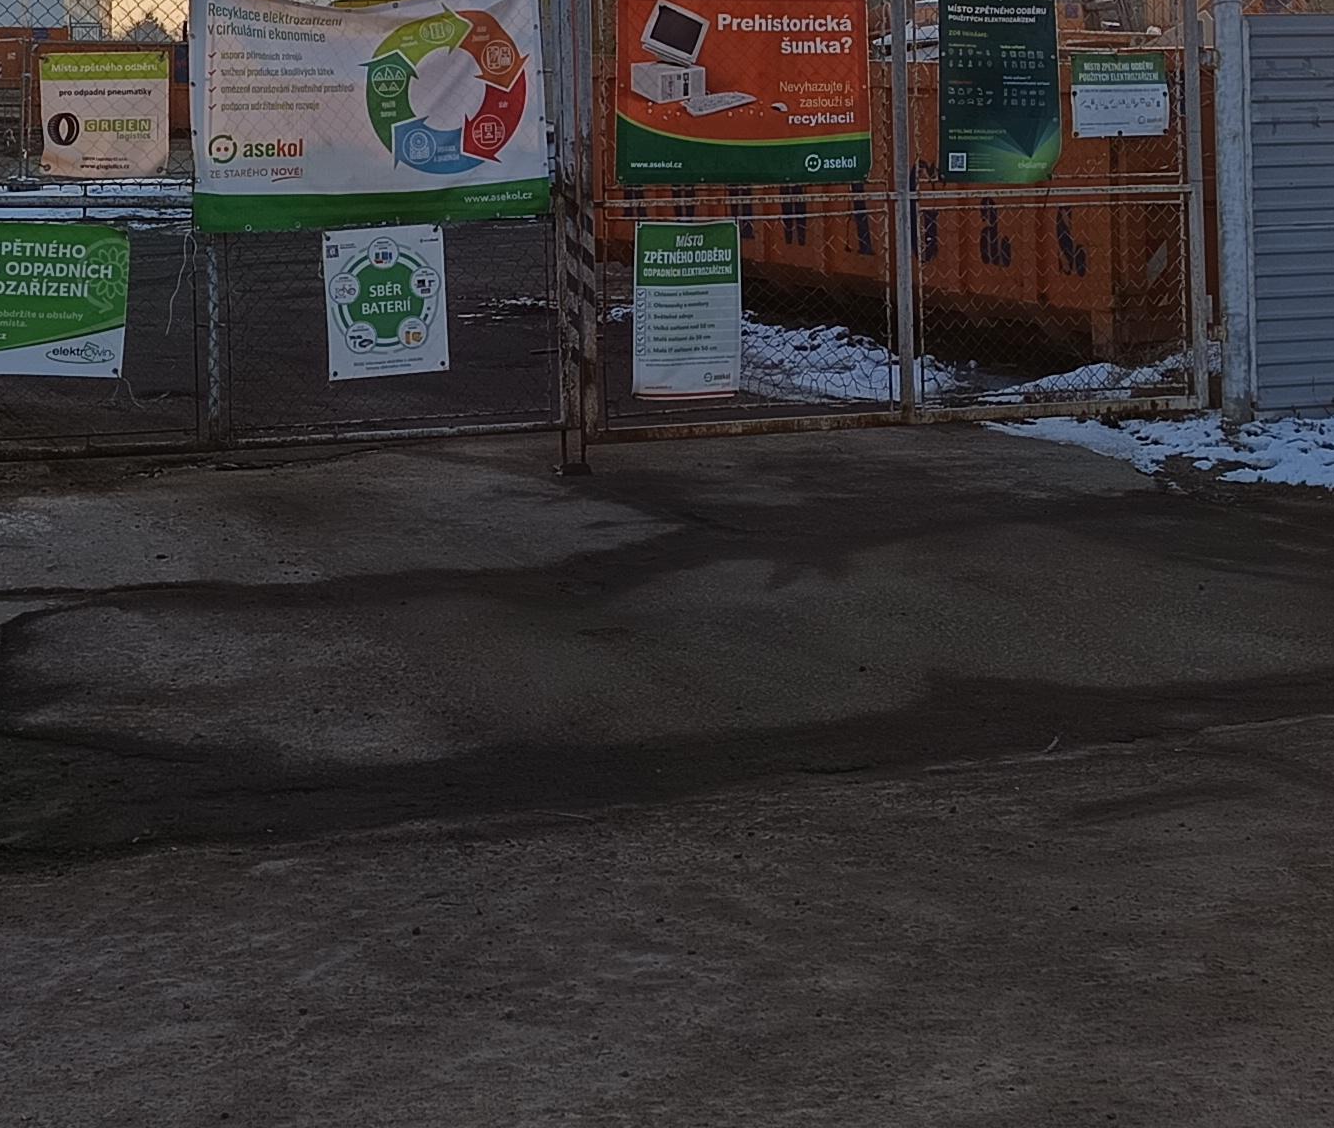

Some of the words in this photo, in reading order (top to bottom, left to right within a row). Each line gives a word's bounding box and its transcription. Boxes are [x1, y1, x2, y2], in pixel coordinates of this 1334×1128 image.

[208, 3, 261, 22] Recyklace
[263, 11, 341, 26] elektrozařízení
[947, 4, 973, 14] MÍSTO
[975, 5, 1015, 14] ZPĚTNÉHO
[1016, 6, 1047, 14] ODBĚRU
[717, 14, 851, 32] Prehistorická
[948, 14, 983, 22] POUŽITÝCH
[208, 25, 213, 35] v
[217, 22, 267, 38] cirkulární
[269, 28, 325, 42] ekonomice
[781, 36, 852, 54] šunka?
[51, 62, 76, 72] Místo
[79, 62, 124, 74] zpětného
[127, 61, 157, 72] odběru
[1084, 62, 1100, 71] MÍSTO
[1131, 61, 1153, 70] ODBĚRU
[1079, 72, 1109, 82] POUŽITÝCH
[59, 90, 71, 98] pro
[73, 87, 105, 98] odpadní
[107, 87, 153, 98] pneumatiky
[779, 81, 842, 94] Nevyhazujte
[221, 102, 249, 112] podpora
[295, 102, 319, 111] rozvoje
[799, 97, 842, 108] zaslouží
[845, 98, 853, 107] si
[789, 112, 854, 126] recyklaci!
[84, 120, 151, 132] GREEN
[116, 132, 151, 142] logistics
[243, 138, 303, 158] asekol
[631, 160, 683, 169] www.asekol.cz
[823, 156, 857, 169] asekol
[210, 170, 221, 178] ZE
[224, 168, 268, 178] STARÉHO
[271, 166, 303, 176] NOVÉ!
[464, 190, 533, 203] www.asekol.cz
[676, 233, 703, 247] MÍSTO
[644, 250, 693, 264] ZPĚTNÉHO
[695, 247, 731, 262] ODBĚRU
[5, 261, 113, 278] ODPADNÍCH
[643, 266, 681, 277] ODPADNÍCH
[682, 264, 733, 277] ELEKTROZAŘÍZENÍ
[369, 281, 403, 297] SBĚR
[362, 296, 411, 314] BATERIÍ
[47, 311, 83, 321] obsluhy
[0, 318, 27, 328] místa.
